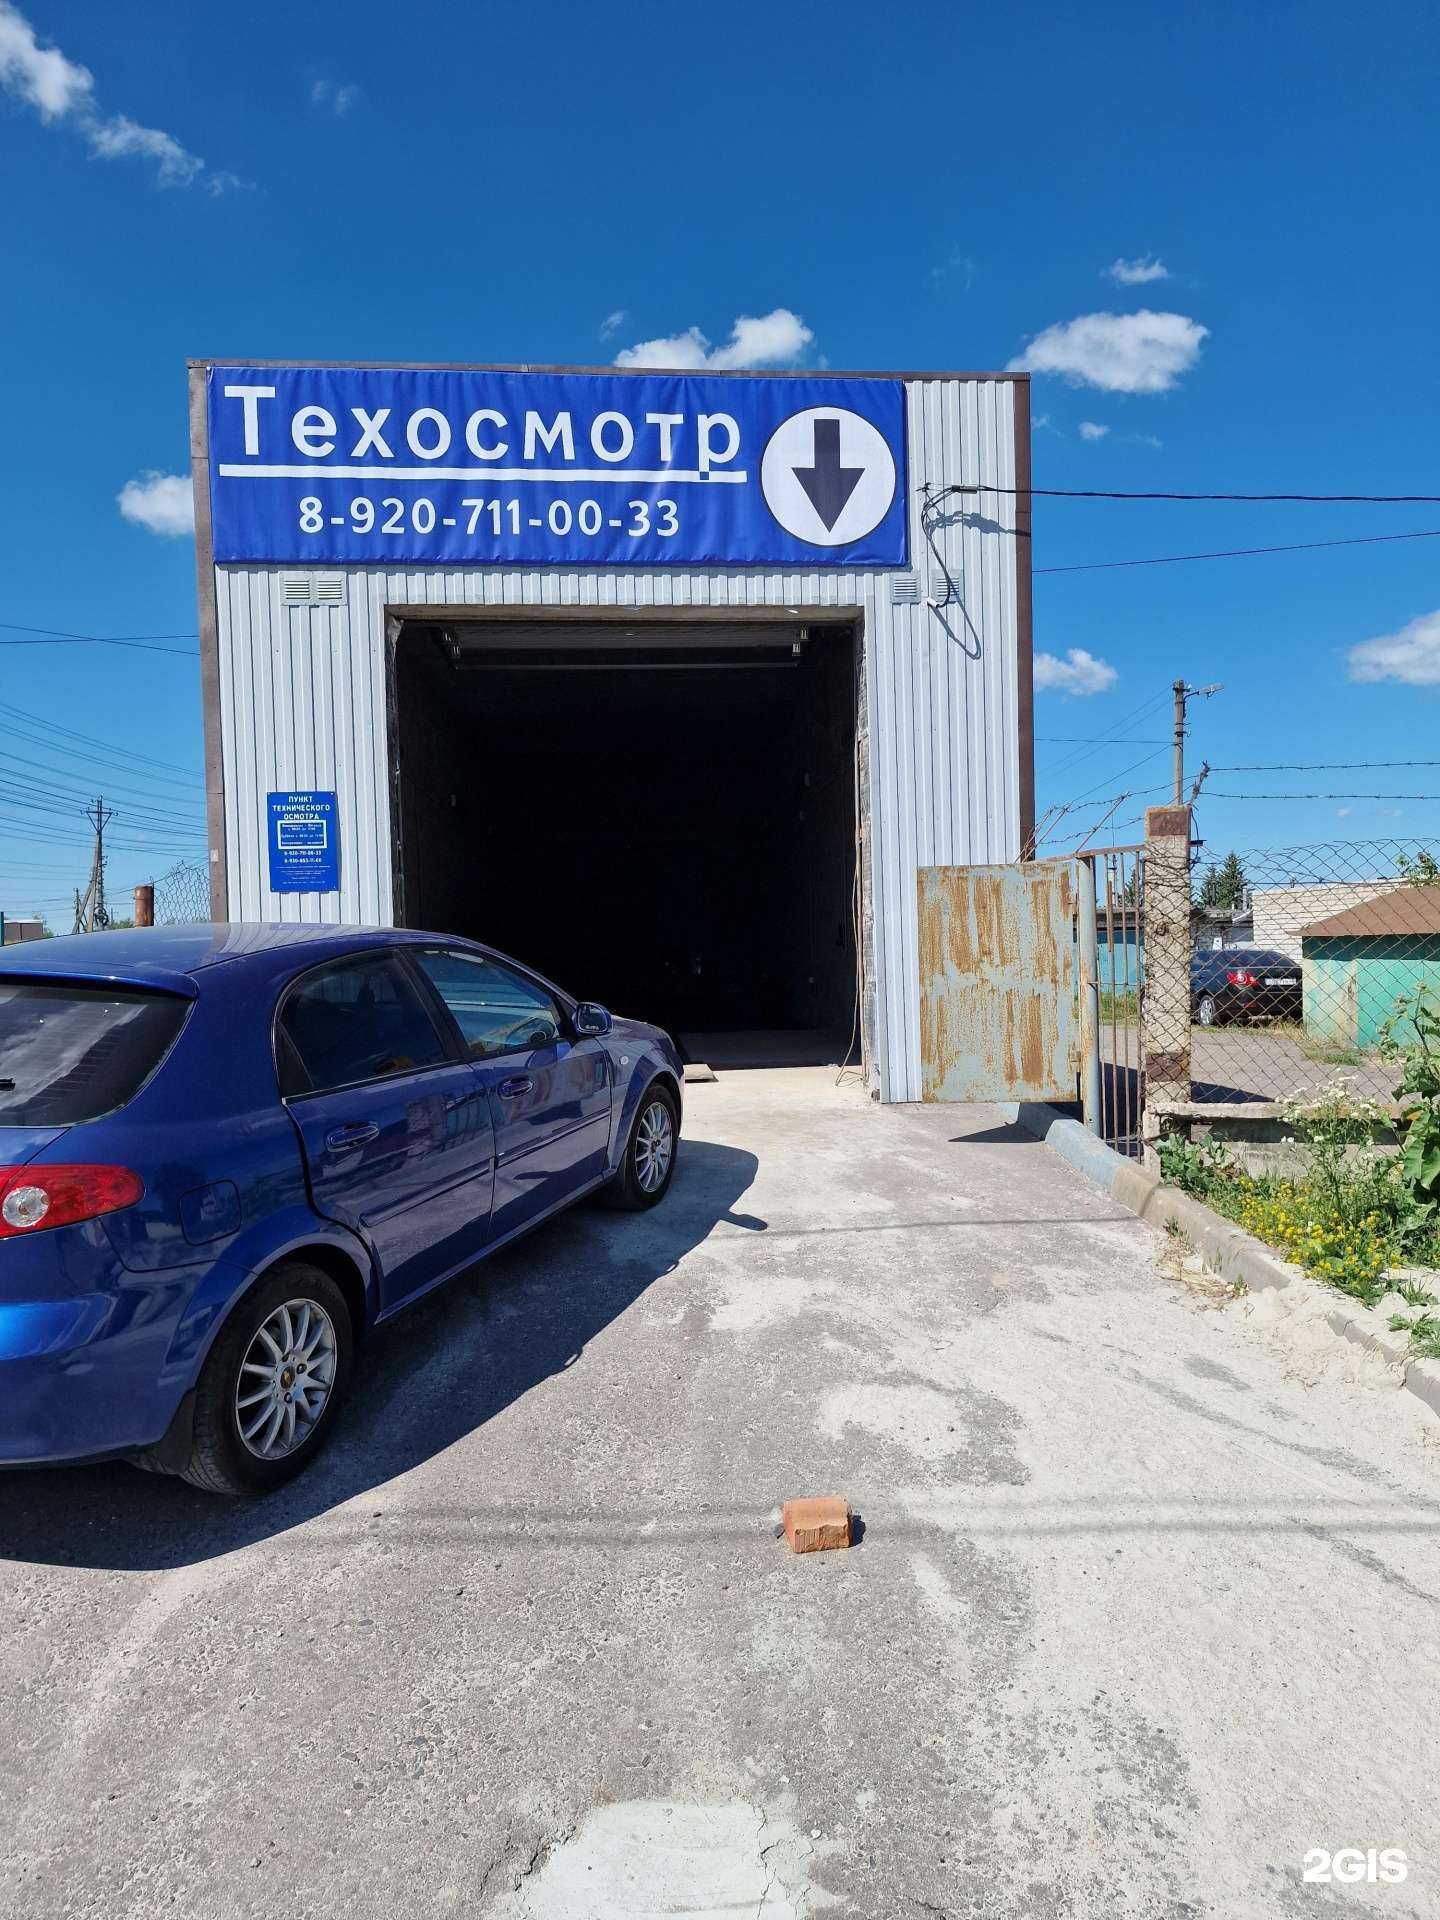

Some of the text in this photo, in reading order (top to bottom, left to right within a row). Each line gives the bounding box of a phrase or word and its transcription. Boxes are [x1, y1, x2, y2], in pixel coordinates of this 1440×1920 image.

[224, 385, 741, 476] Техосмотр
[299, 496, 680, 537] 8-920-711-00-33
[272, 804, 331, 812] ТЕХНИЧЕСКОГО
[288, 795, 313, 803] ПУНКТ
